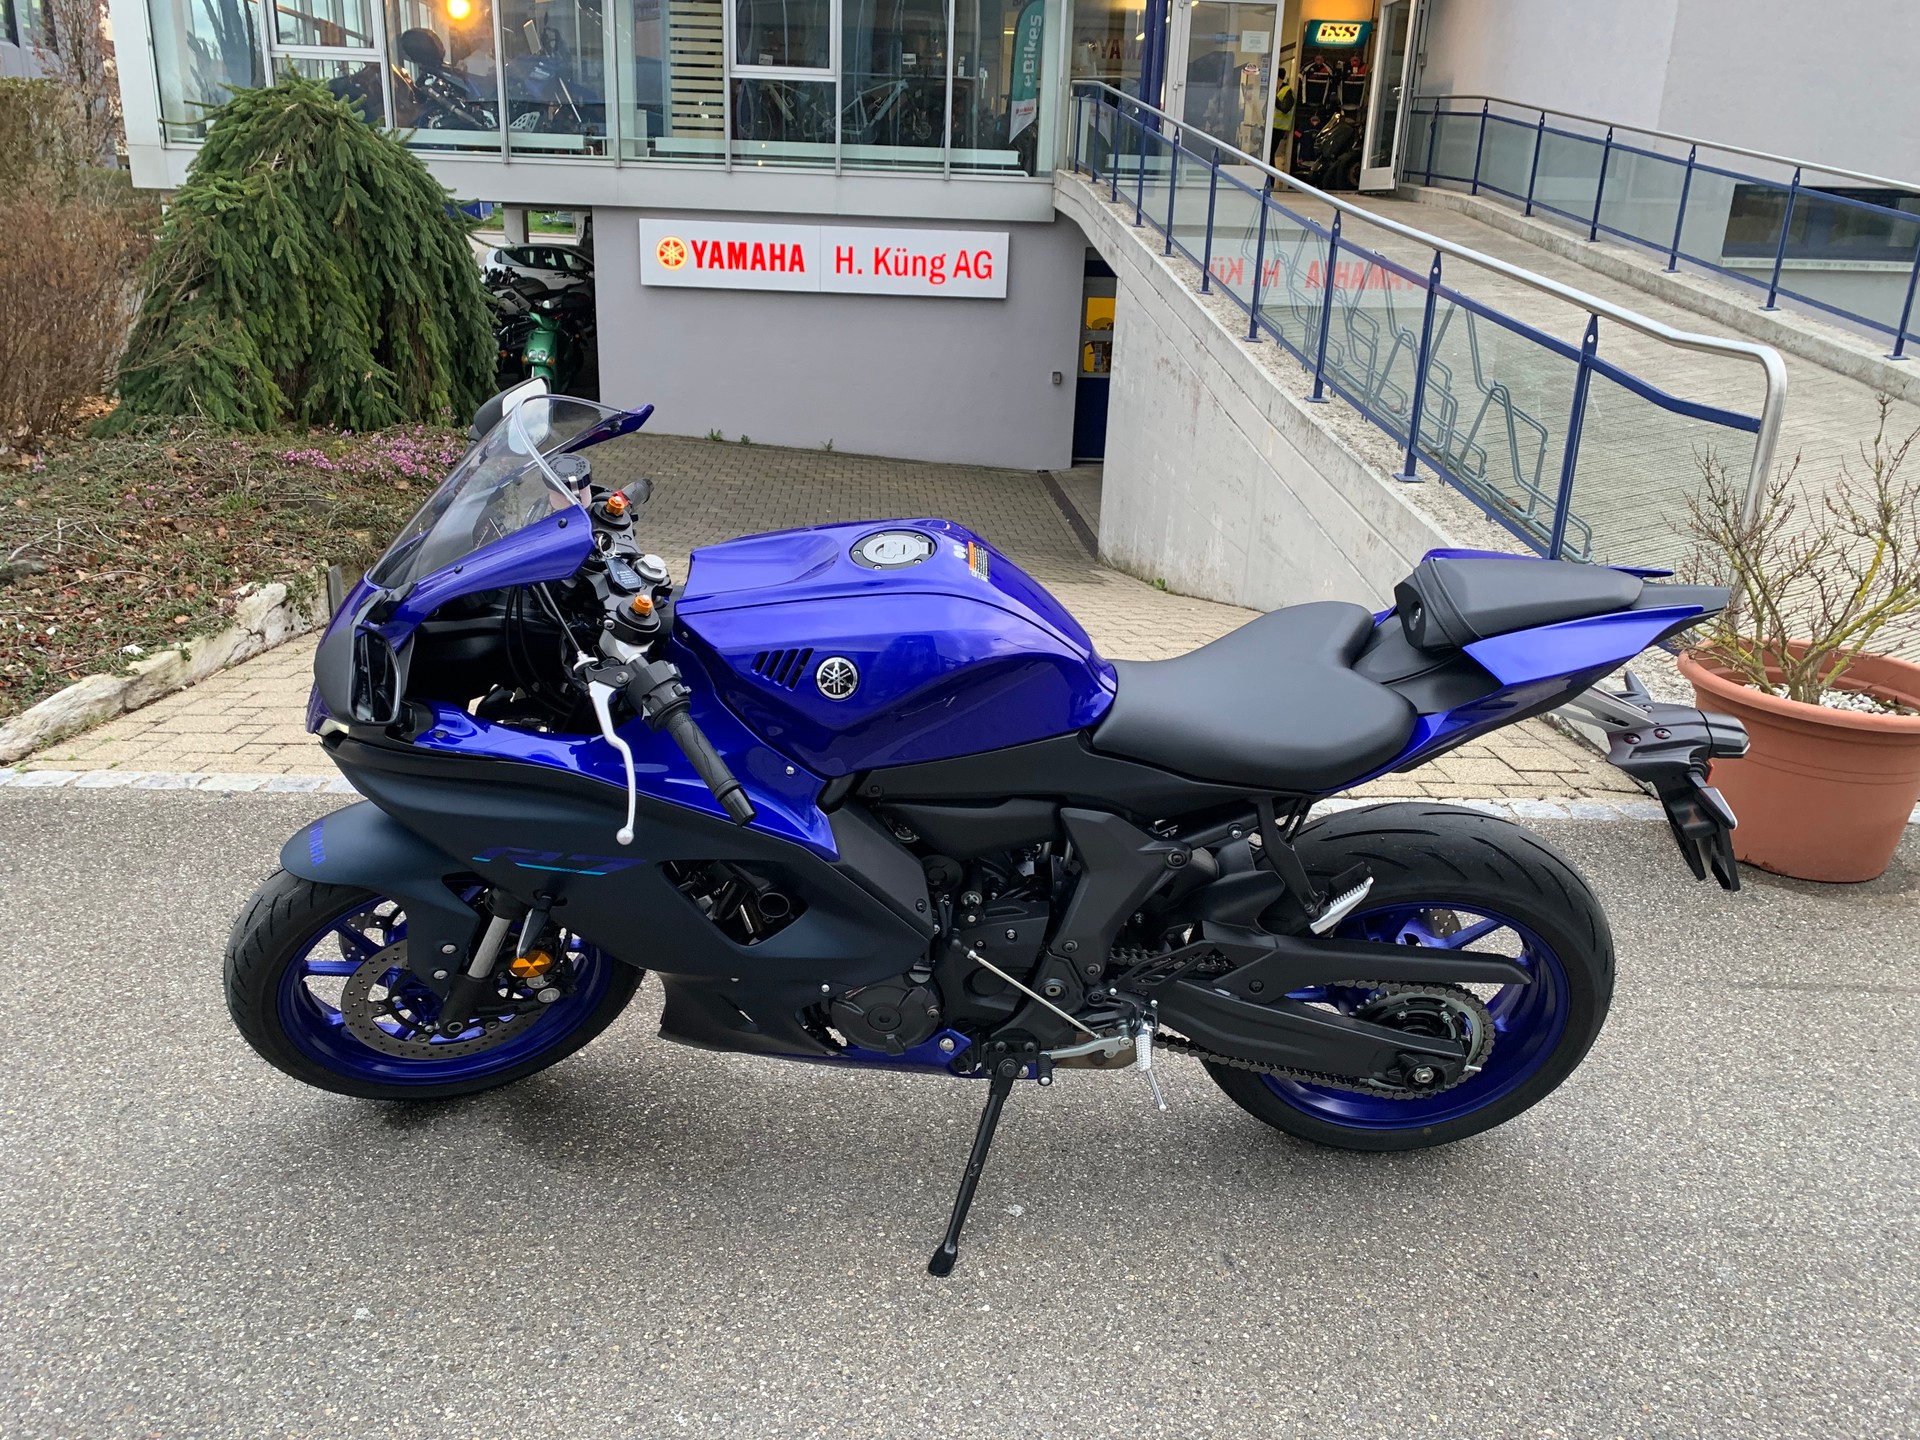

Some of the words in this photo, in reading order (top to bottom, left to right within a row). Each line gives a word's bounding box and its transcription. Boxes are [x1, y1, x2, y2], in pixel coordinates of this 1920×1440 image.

[1023, 14, 1042, 88] eBikes
[690, 240, 805, 273] YAMAHA
[835, 245, 863, 275] H.
[873, 246, 946, 285] Küng
[952, 249, 993, 280] AG
